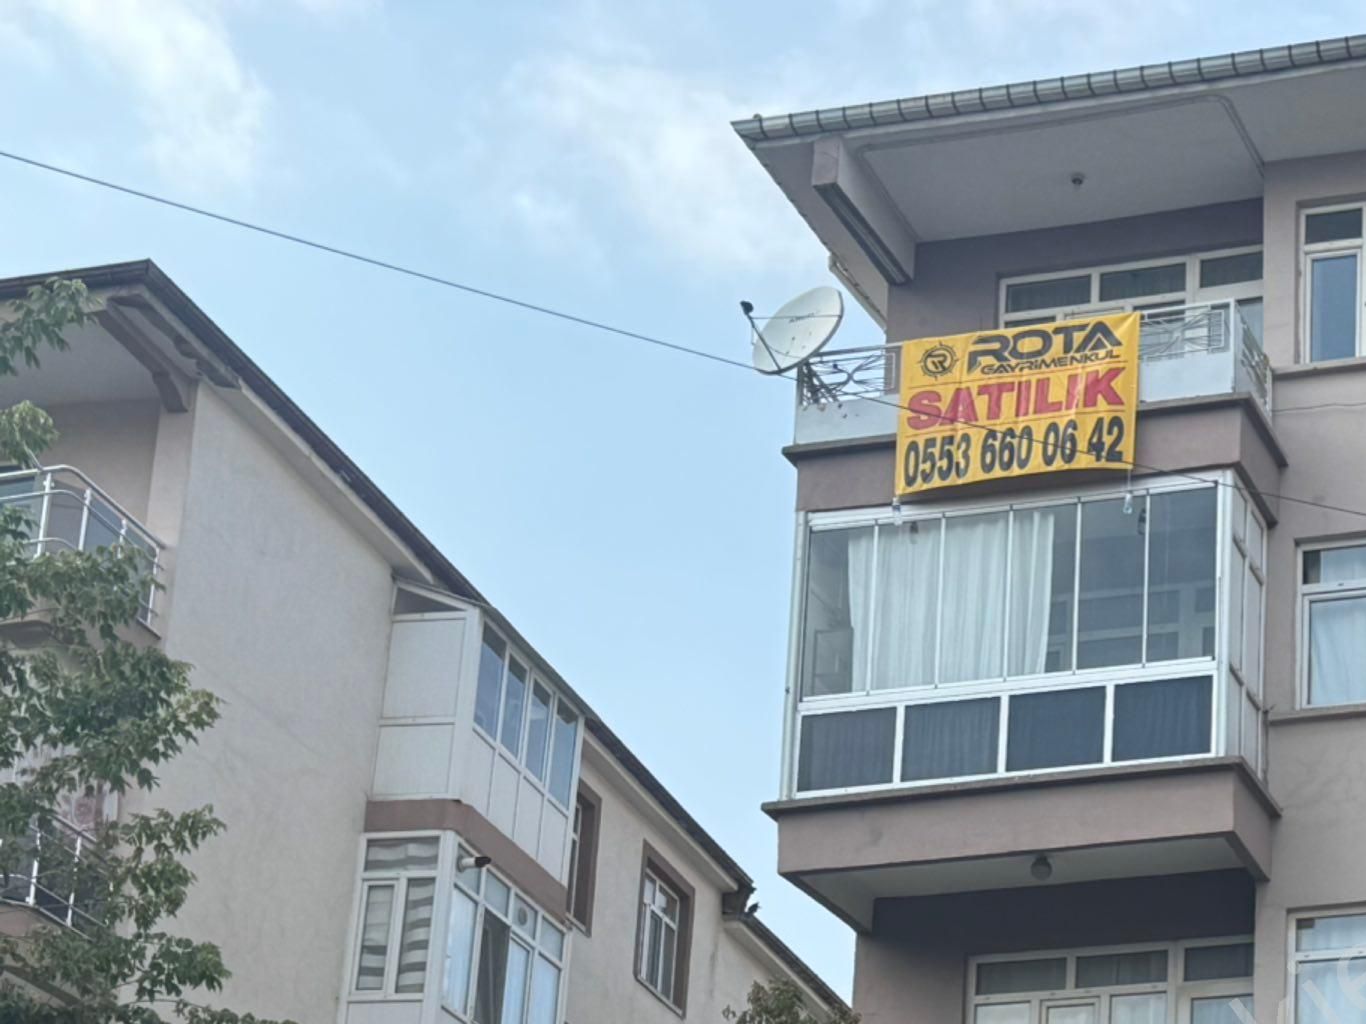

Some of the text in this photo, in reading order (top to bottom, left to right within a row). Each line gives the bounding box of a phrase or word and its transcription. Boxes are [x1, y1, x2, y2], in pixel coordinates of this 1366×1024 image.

[967, 321, 1123, 374] ROTA
[907, 366, 1127, 430] SATILIK
[904, 416, 1124, 487] 0553 660 06 42
